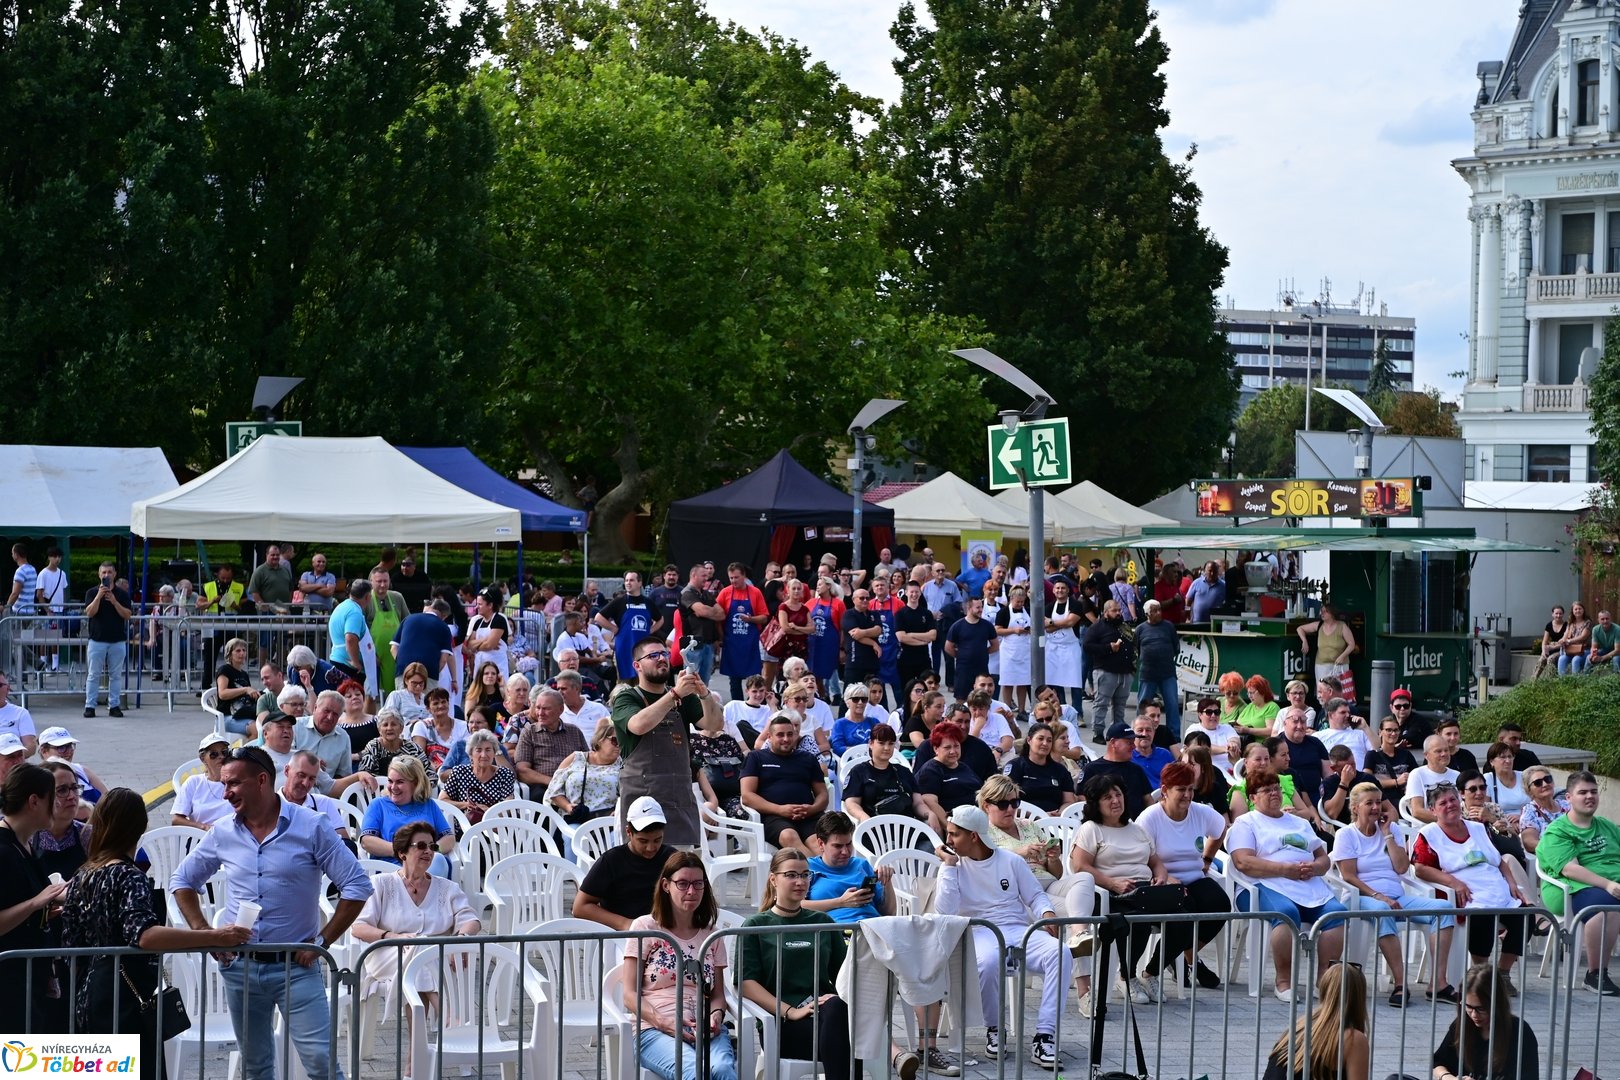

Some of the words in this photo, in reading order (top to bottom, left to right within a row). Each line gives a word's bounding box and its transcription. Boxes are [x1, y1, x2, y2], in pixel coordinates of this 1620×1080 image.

[1270, 482, 1329, 515] SÖR
[1173, 650, 1207, 673] Licher
[1283, 649, 1310, 681] Lich
[1403, 645, 1443, 677] Licher
